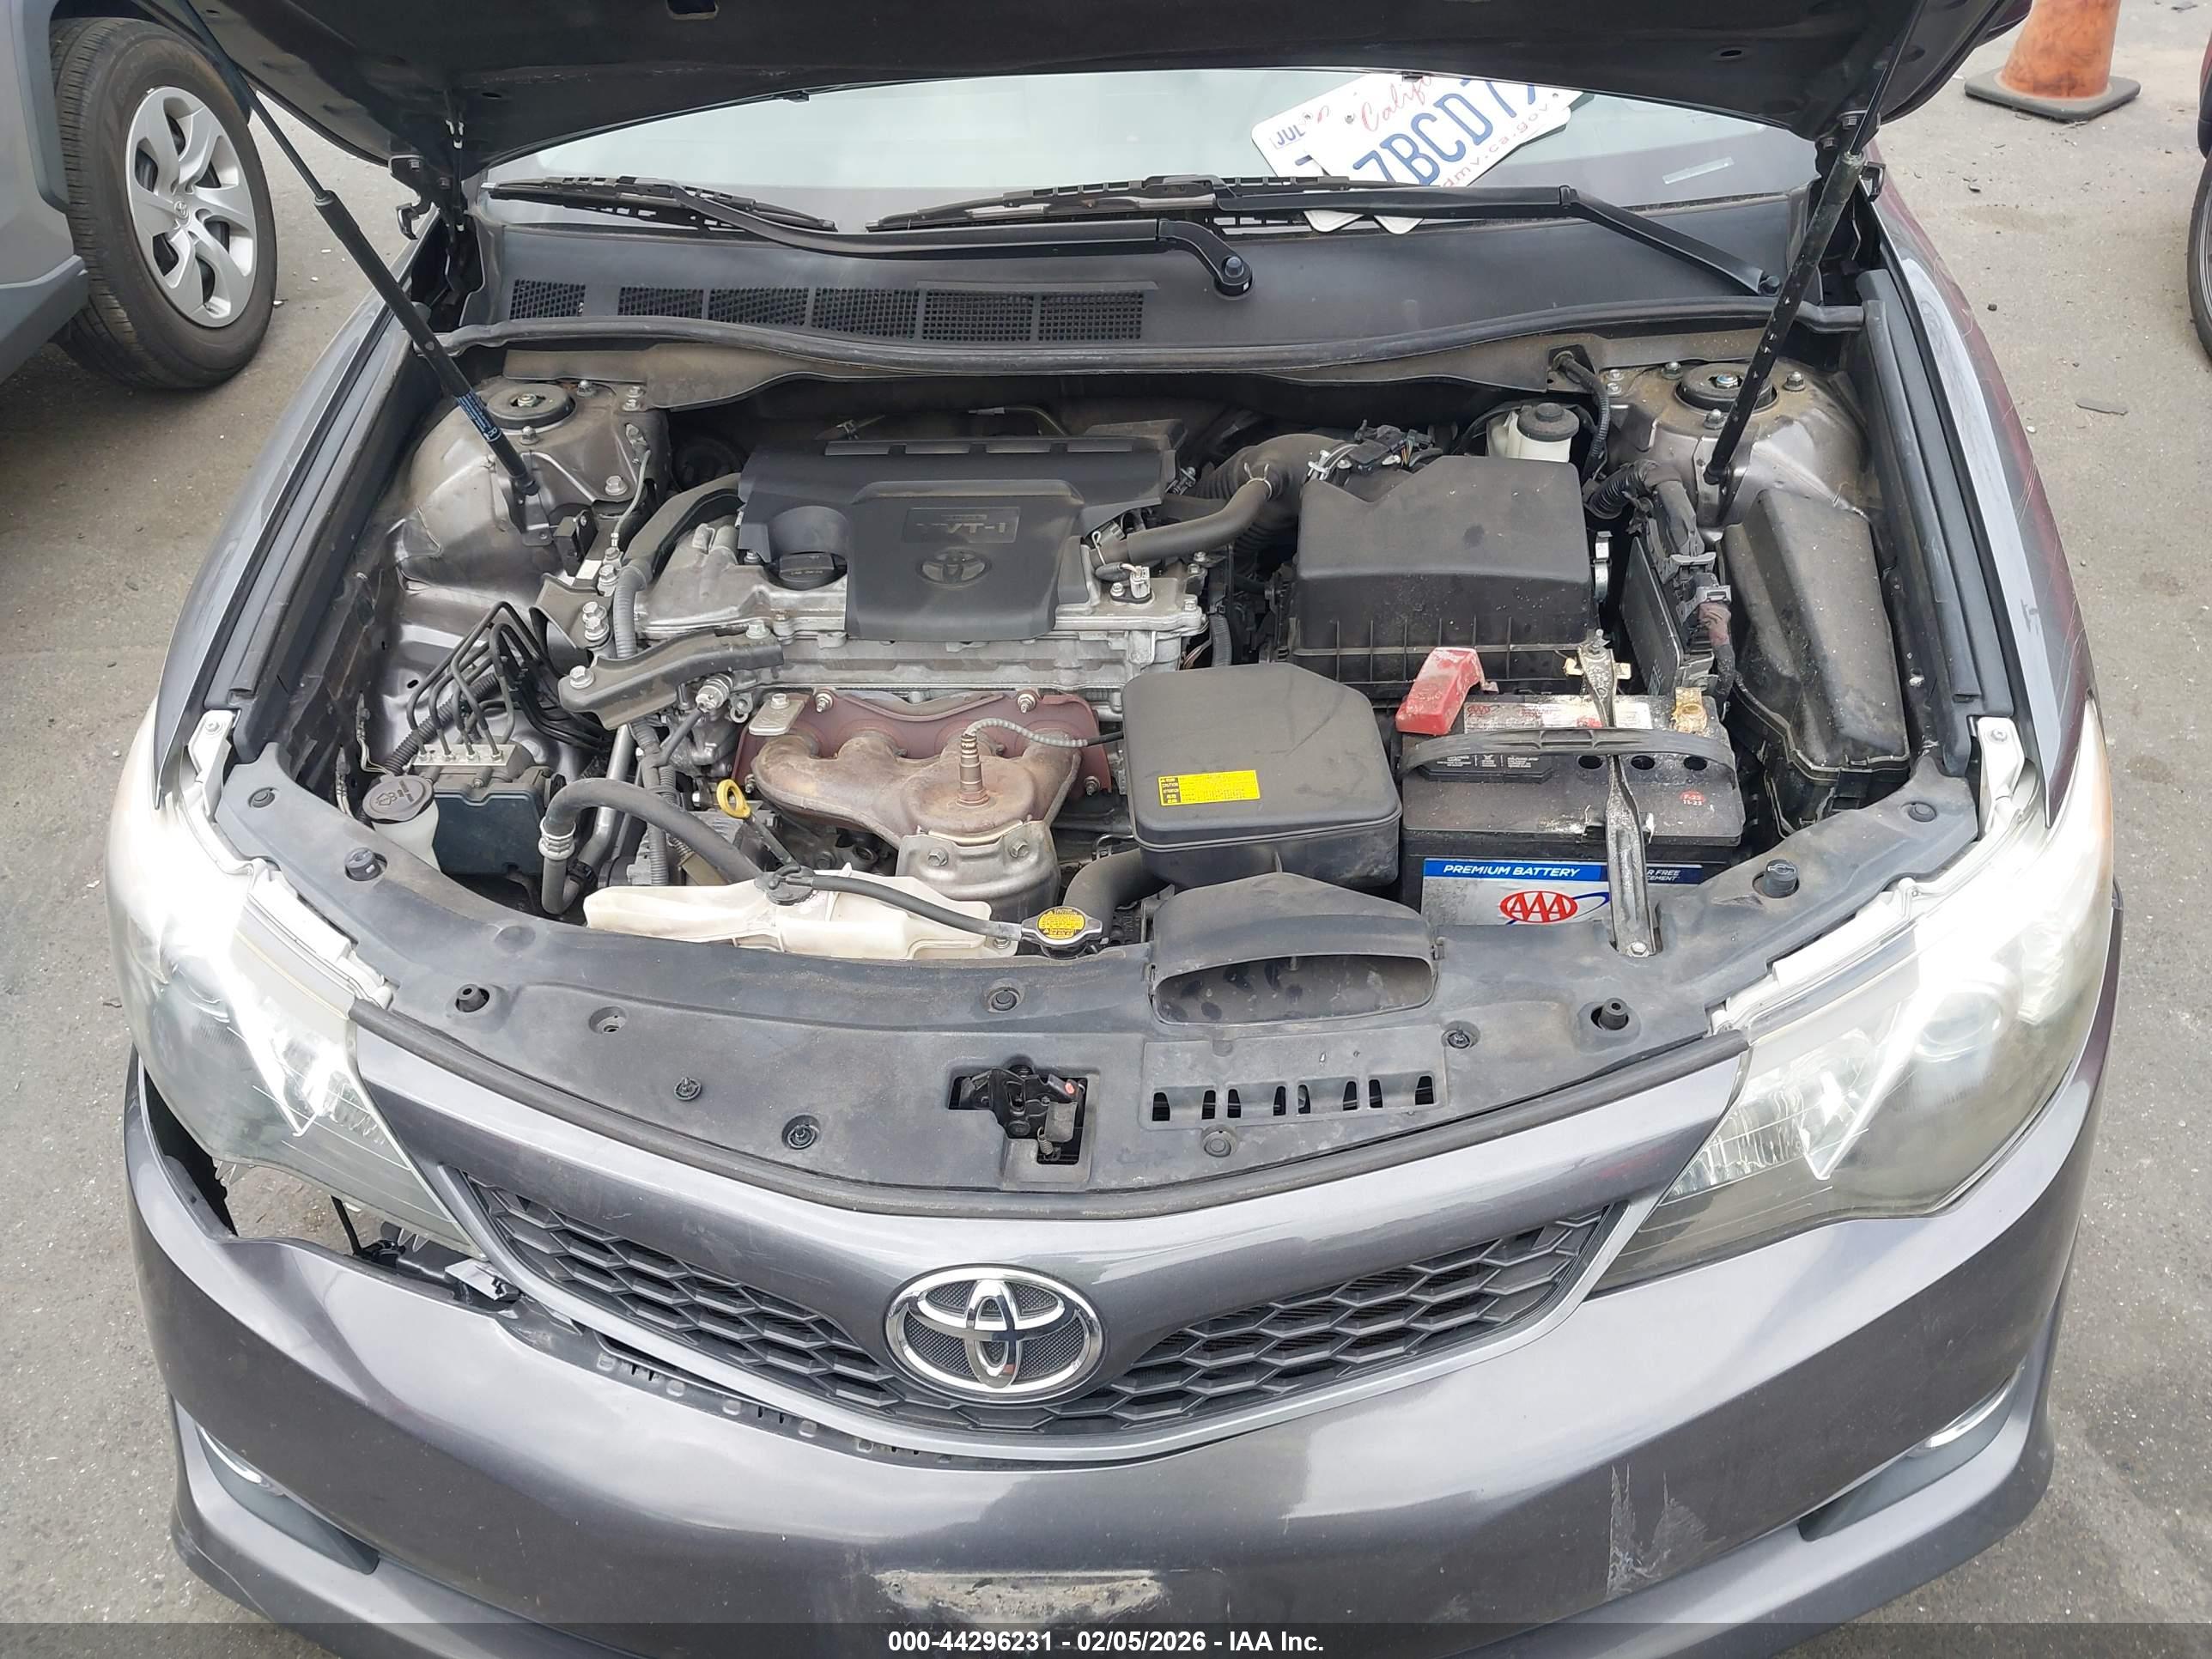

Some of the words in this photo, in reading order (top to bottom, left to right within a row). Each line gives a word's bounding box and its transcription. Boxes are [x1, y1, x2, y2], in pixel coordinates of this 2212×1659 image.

[1276, 125, 1305, 146] JUL
[1443, 864, 1510, 877] PREMIUM
[1513, 866, 1581, 878] BATTERY
[1507, 890, 1570, 922] AAA
